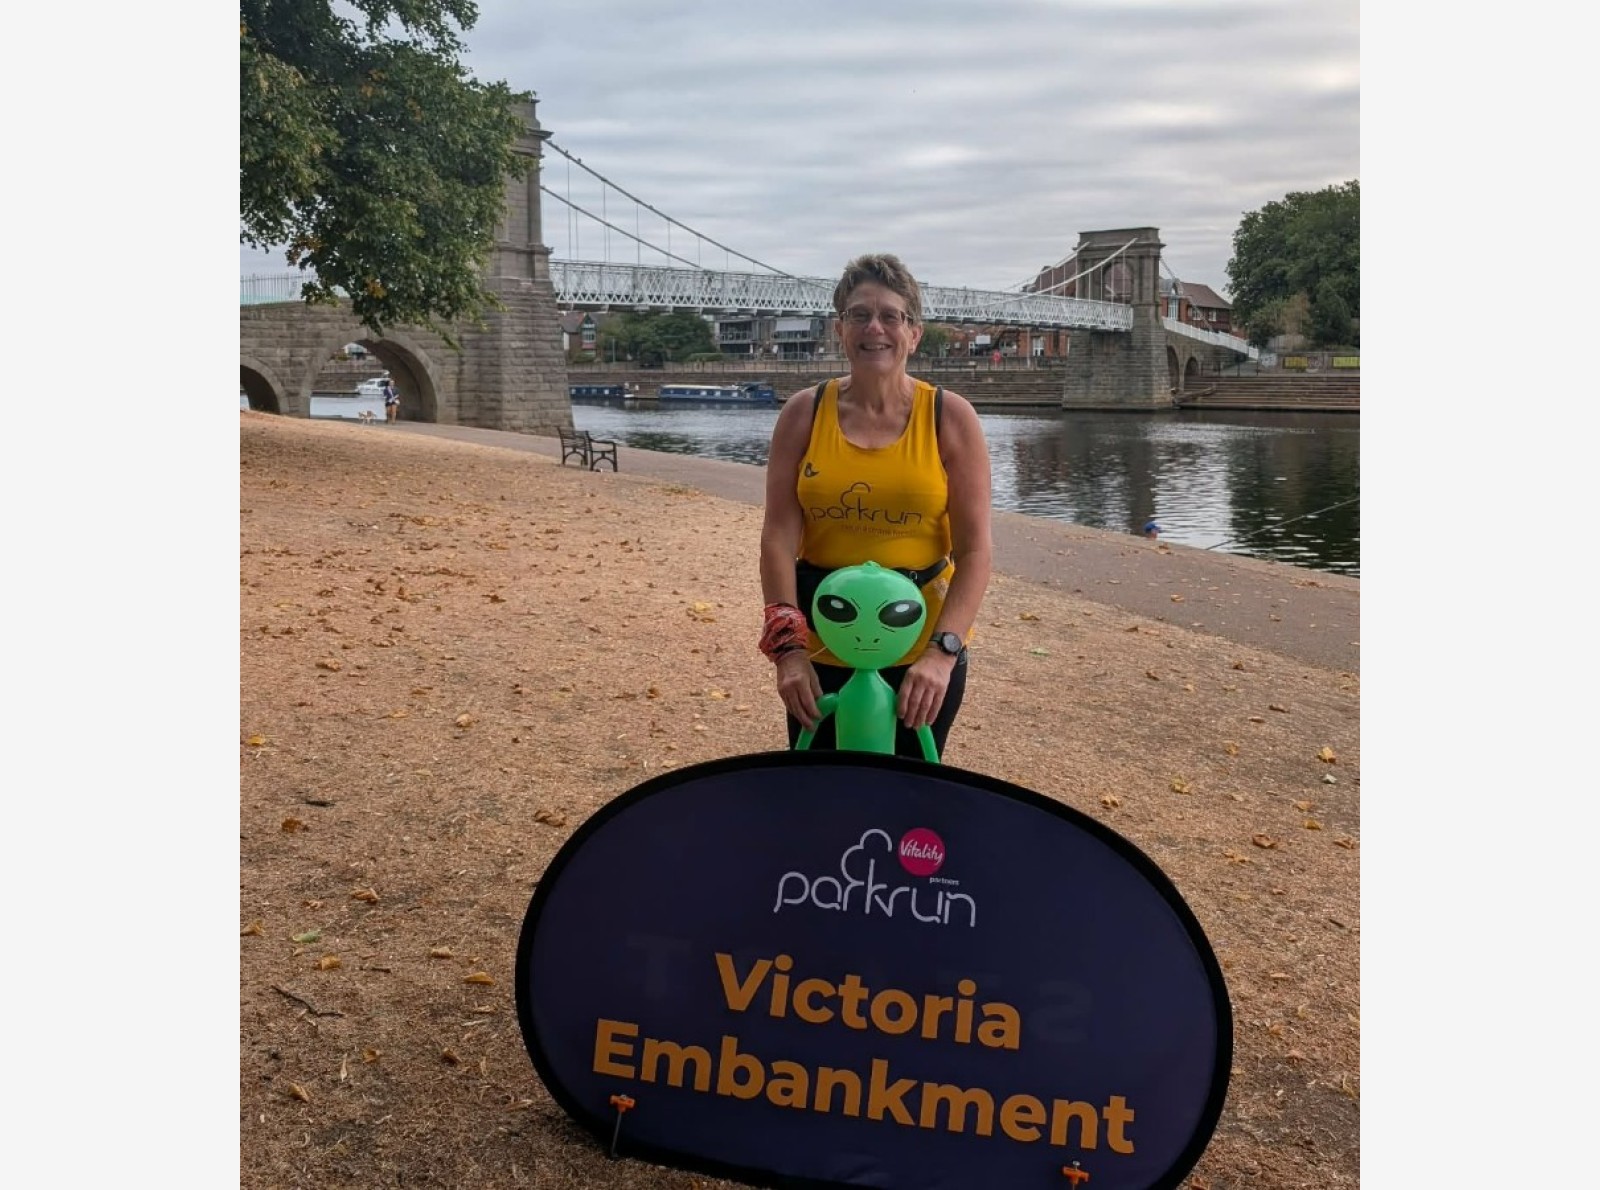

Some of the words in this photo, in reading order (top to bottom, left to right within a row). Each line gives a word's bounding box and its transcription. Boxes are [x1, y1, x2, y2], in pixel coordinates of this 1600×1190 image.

[809, 482, 922, 525] parkrun
[773, 828, 976, 928] parkrun
[900, 839, 943, 866] Vitality
[715, 953, 1022, 1050] Victoria
[593, 1018, 1136, 1155] Embankment
